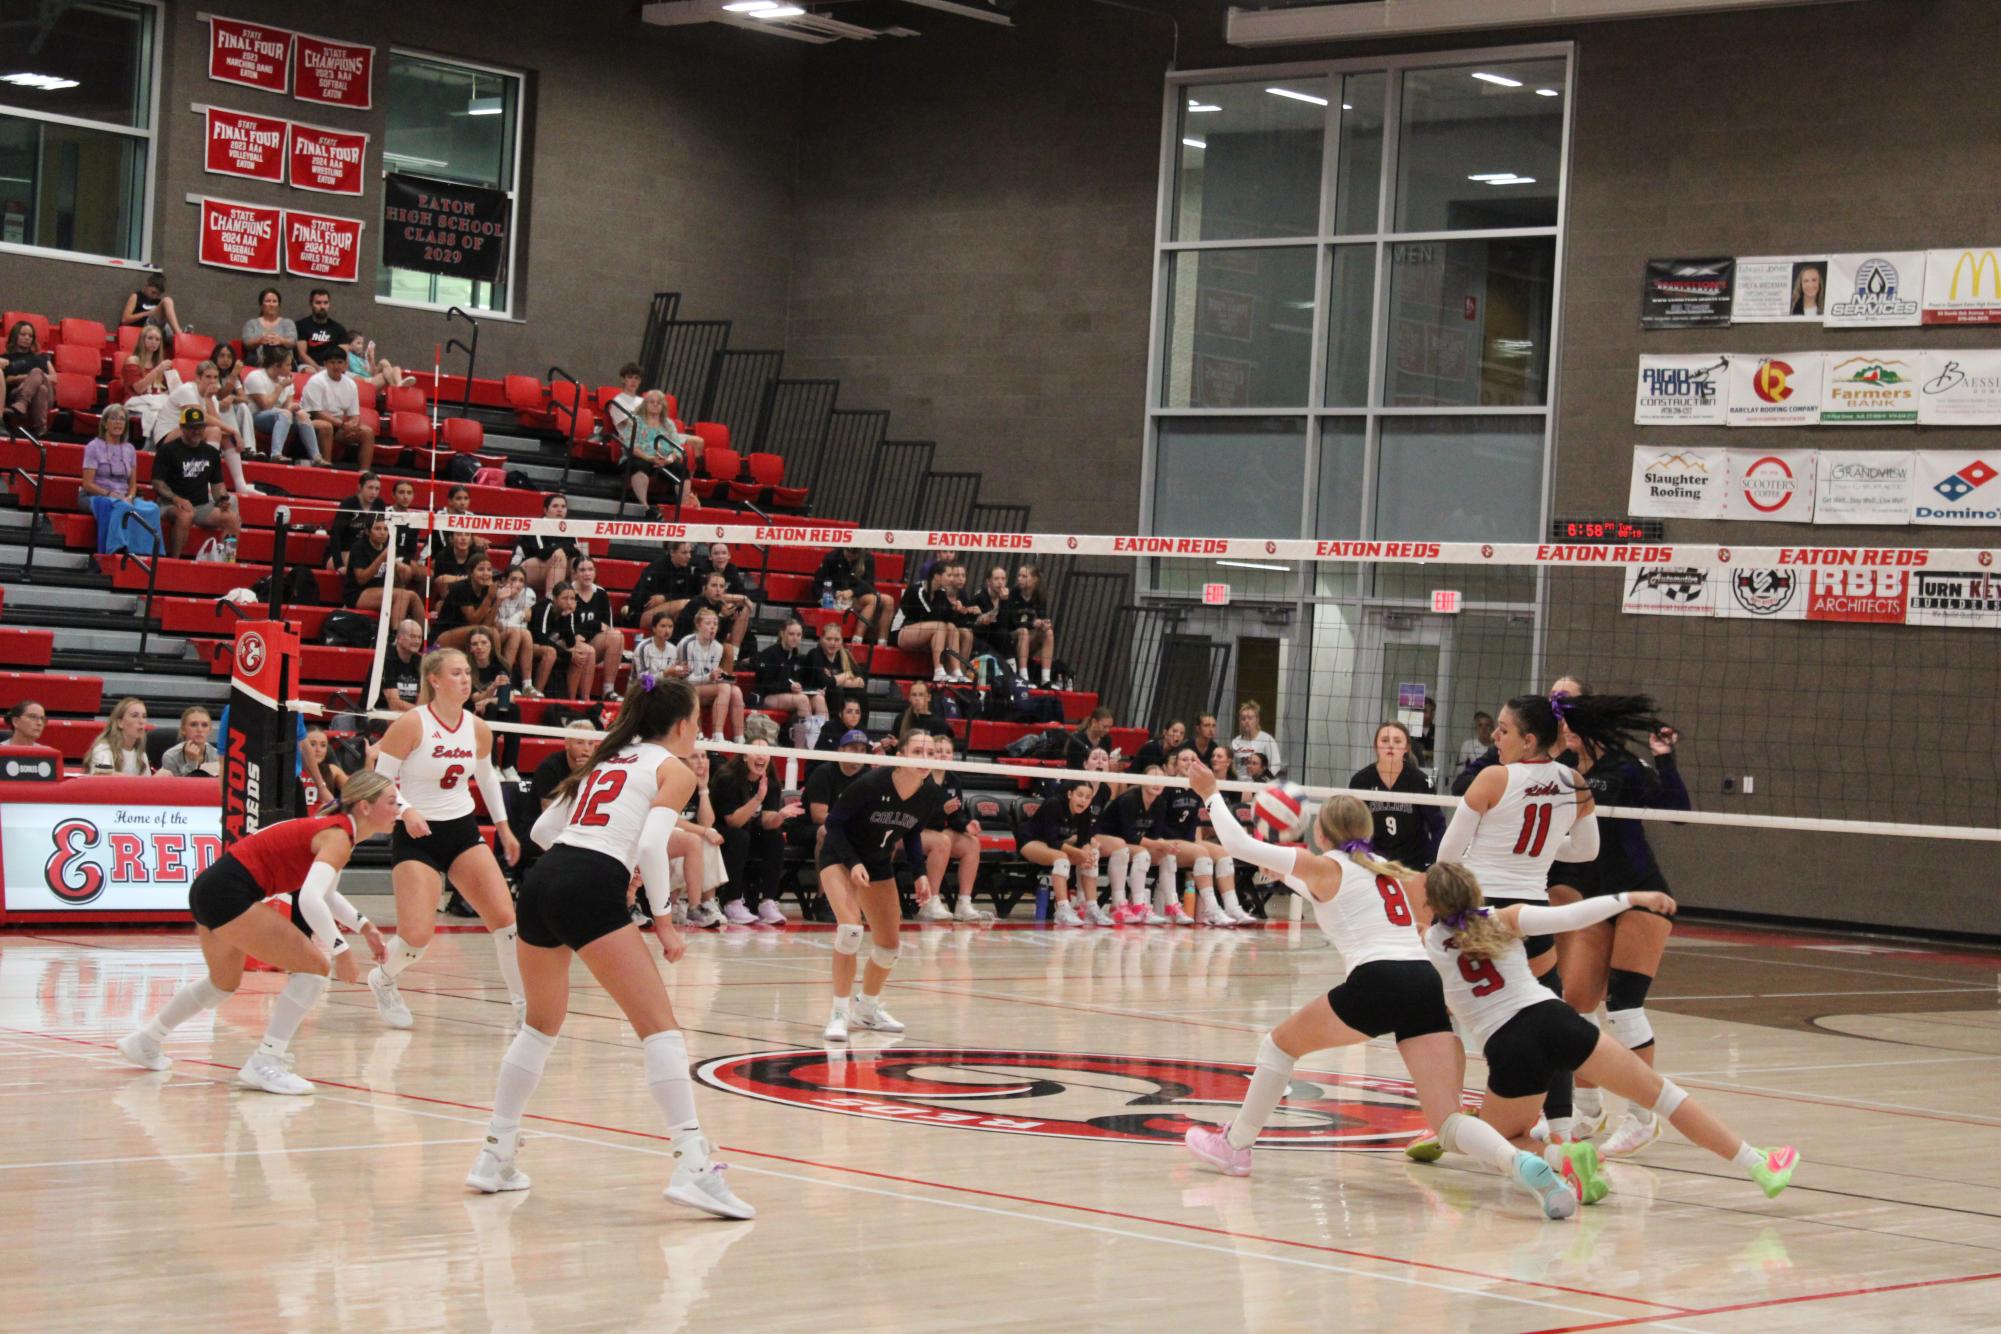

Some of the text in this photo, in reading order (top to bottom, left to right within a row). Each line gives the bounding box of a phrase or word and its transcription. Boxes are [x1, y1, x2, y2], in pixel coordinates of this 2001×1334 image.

[242, 29, 262, 39] STATE
[218, 30, 284, 61] FINAL FOUR
[323, 47, 347, 58] STATE
[304, 49, 364, 75] CHAMPIONS
[240, 69, 258, 79] EATON
[318, 79, 348, 90] SOFTBALL
[322, 89, 342, 99] EATON
[238, 120, 257, 130] STATE
[213, 121, 280, 149] FINAL FOUR
[318, 136, 337, 146] STATE
[249, 143, 263, 153] AAA
[295, 137, 359, 164] FINAL FOUR
[228, 150, 263, 162] VOLLEYBALL
[236, 160, 255, 170] EATON
[312, 165, 343, 177] WRESTLING
[329, 159, 343, 169] AAA
[317, 175, 336, 185] EATON
[418, 194, 475, 216] EATON
[230, 209, 255, 221] STATE
[386, 206, 504, 237] HIGH SCHOOL
[210, 211, 272, 239] CHAMPIONS
[311, 219, 336, 232] STATE
[221, 232, 257, 247] 2024 AAA
[291, 223, 352, 251] FINAL FOUR
[403, 226, 485, 251] CLASS OF
[223, 243, 255, 256] BASEBALL
[304, 242, 339, 257] 2024 AAA
[424, 246, 463, 264] 2029
[230, 253, 249, 264] EATON
[300, 252, 341, 266] GIRLS TRACK
[311, 264, 330, 273] EATON
[1851, 293, 1899, 304] NAILL
[1832, 302, 1917, 316] SERVICES
[1643, 368, 1689, 383] RIGID
[1650, 381, 1716, 397] ROOTS
[1832, 388, 1912, 399] Farmers
[1640, 398, 1716, 407] CONSTRUCTION
[1789, 405, 1819, 413] COMPANY
[1644, 472, 1709, 486] Slaughter
[1832, 464, 1908, 480] GRANDVIEW
[1650, 486, 1702, 500] Roofing
[448, 515, 531, 531] EATON REDS
[595, 522, 686, 537] EATON REDS
[1567, 522, 1603, 537] 6:58
[755, 527, 853, 543] EATON REDS
[927, 532, 1033, 548] EATON REDS
[1113, 537, 1228, 554] EATON REDS
[1316, 541, 1441, 558] EATON REDS
[1536, 545, 1673, 562] EATON REDS
[1777, 549, 1929, 566] EATON REDS
[1815, 569, 1902, 598] RBB
[1913, 571, 1962, 597] TURN
[1206, 585, 1225, 603] EXIT
[1435, 592, 1455, 611] EXIT
[1814, 598, 1901, 615] ARCHITECTS
[432, 745, 473, 759] Eaton
[440, 764, 465, 790] 6
[246, 761, 260, 835] REDS
[569, 769, 628, 827] 12
[114, 810, 188, 828] Home of the
[1385, 815, 1397, 836] 9
[1512, 802, 1553, 858] 11
[1375, 872, 1412, 927] 8
[1456, 951, 1506, 998] 9
